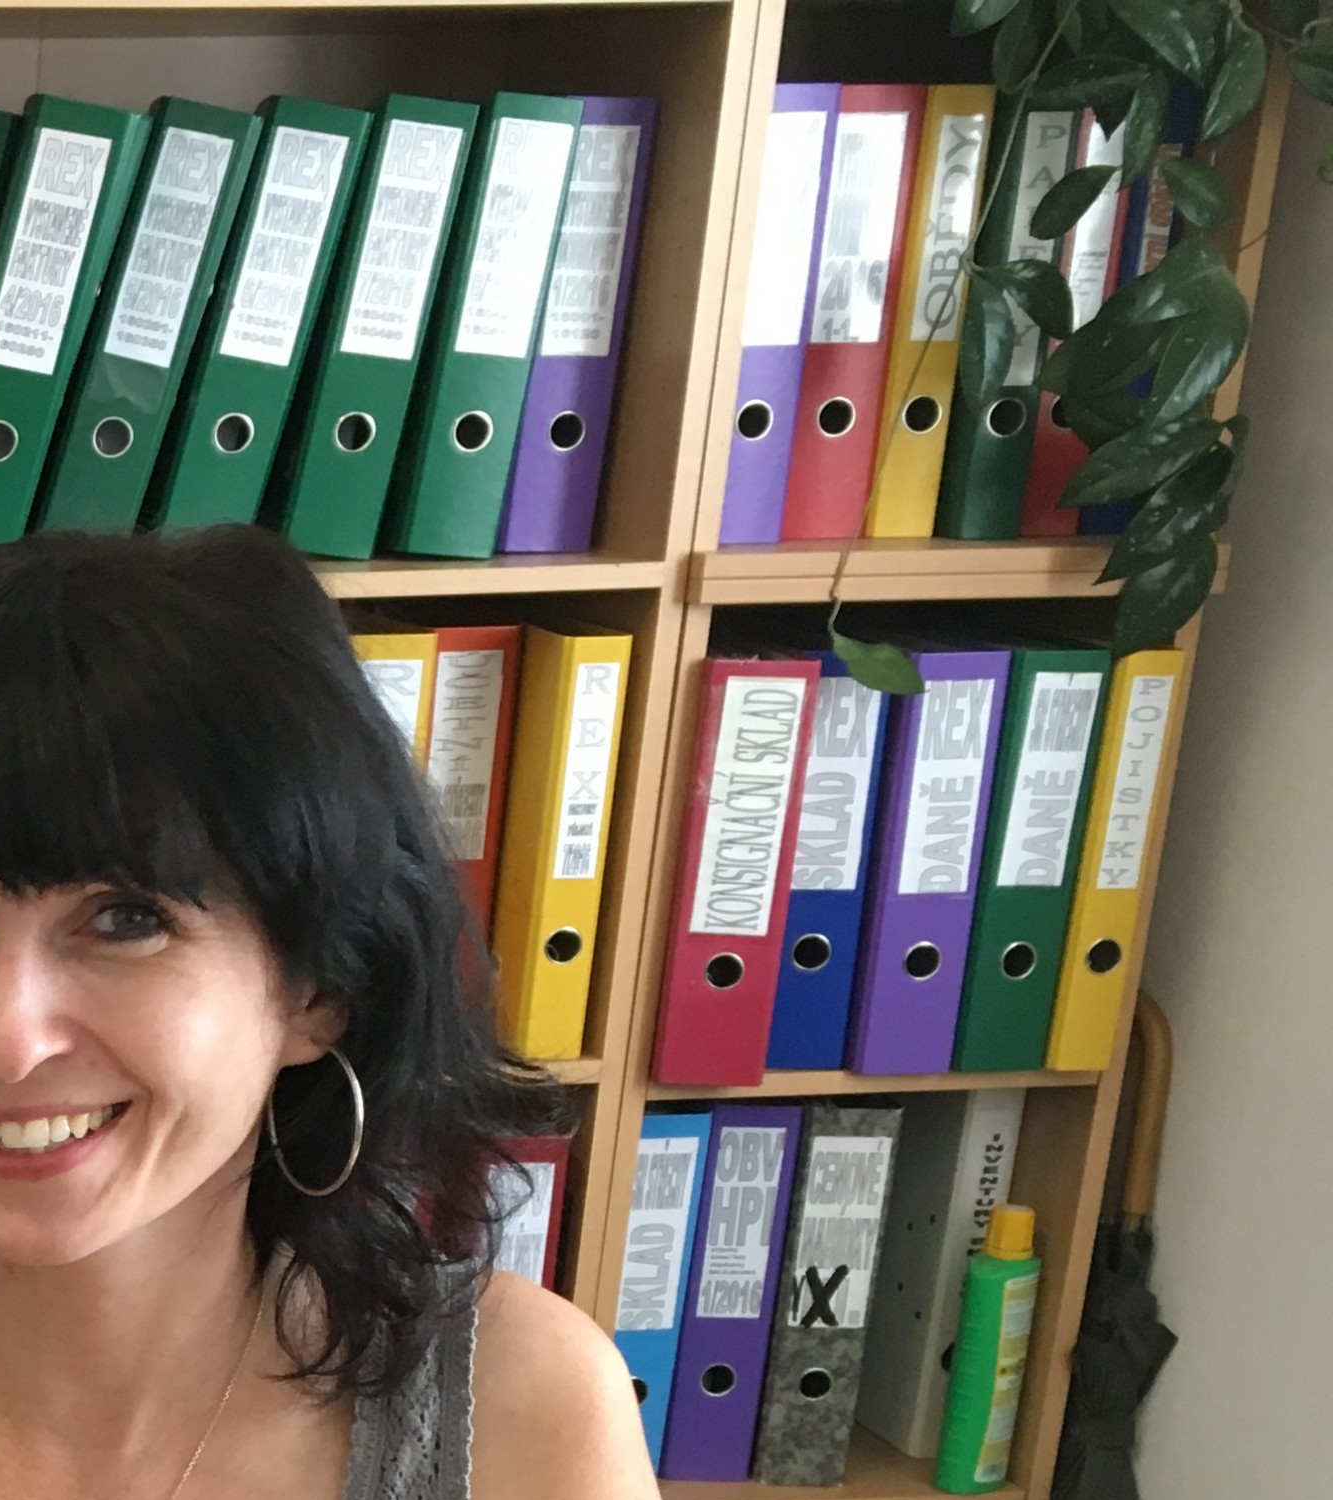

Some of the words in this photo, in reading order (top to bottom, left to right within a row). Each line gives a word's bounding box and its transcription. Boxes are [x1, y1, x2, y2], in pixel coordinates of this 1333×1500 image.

[35, 137, 105, 198] REX
[158, 134, 229, 195] REX
[272, 133, 341, 192] REX
[386, 124, 457, 182] REX
[577, 130, 634, 182] REX
[0, 284, 65, 327] 4/2016
[123, 276, 184, 319] 5/2016
[357, 270, 415, 309] 7/2016
[569, 665, 612, 800] REX
[732, 688, 799, 764] SKLAD
[809, 677, 875, 757] REX
[922, 679, 995, 761] REX
[1101, 678, 1167, 885] POJISTKY
[704, 770, 784, 931] KONSIGNAČNÍ
[792, 771, 857, 889] SKLAD
[919, 776, 975, 893] DANĚ
[1015, 769, 1076, 886] DANĚ
[717, 1132, 787, 1182] OBV
[809, 1139, 885, 1205] CENOVÉ
[708, 1186, 777, 1247] HPI
[618, 1223, 675, 1330] SKLAD
[701, 1280, 763, 1315] 1/2016
[800, 1264, 850, 1329] X
